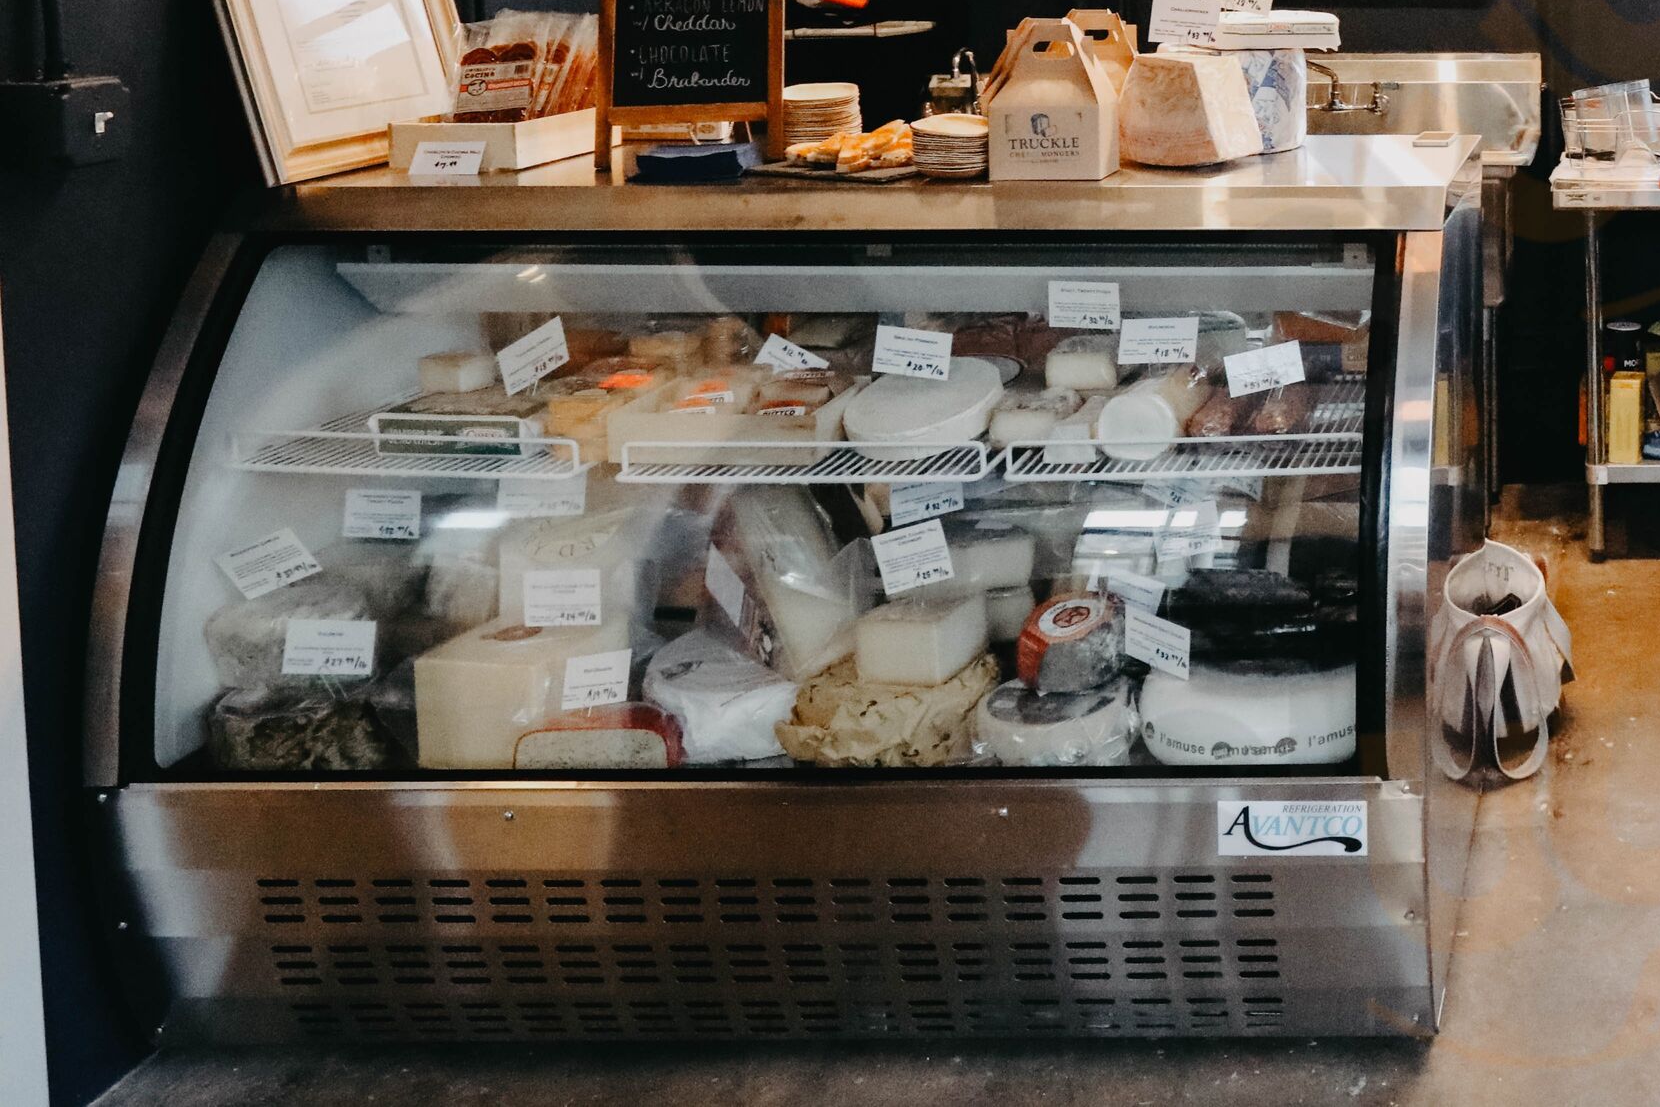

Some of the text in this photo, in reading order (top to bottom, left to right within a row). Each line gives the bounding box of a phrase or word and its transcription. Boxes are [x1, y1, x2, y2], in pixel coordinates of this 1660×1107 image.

[654, 15, 736, 31] Cheddar
[639, 45, 730, 64] CHOCOLATE
[648, 68, 751, 88] Brabander
[1008, 137, 1080, 150] TRUCKLE
[1160, 732, 1206, 755] l'amuse
[1282, 804, 1363, 814] REFRIGERATION
[1222, 805, 1363, 850] AVANTCO
